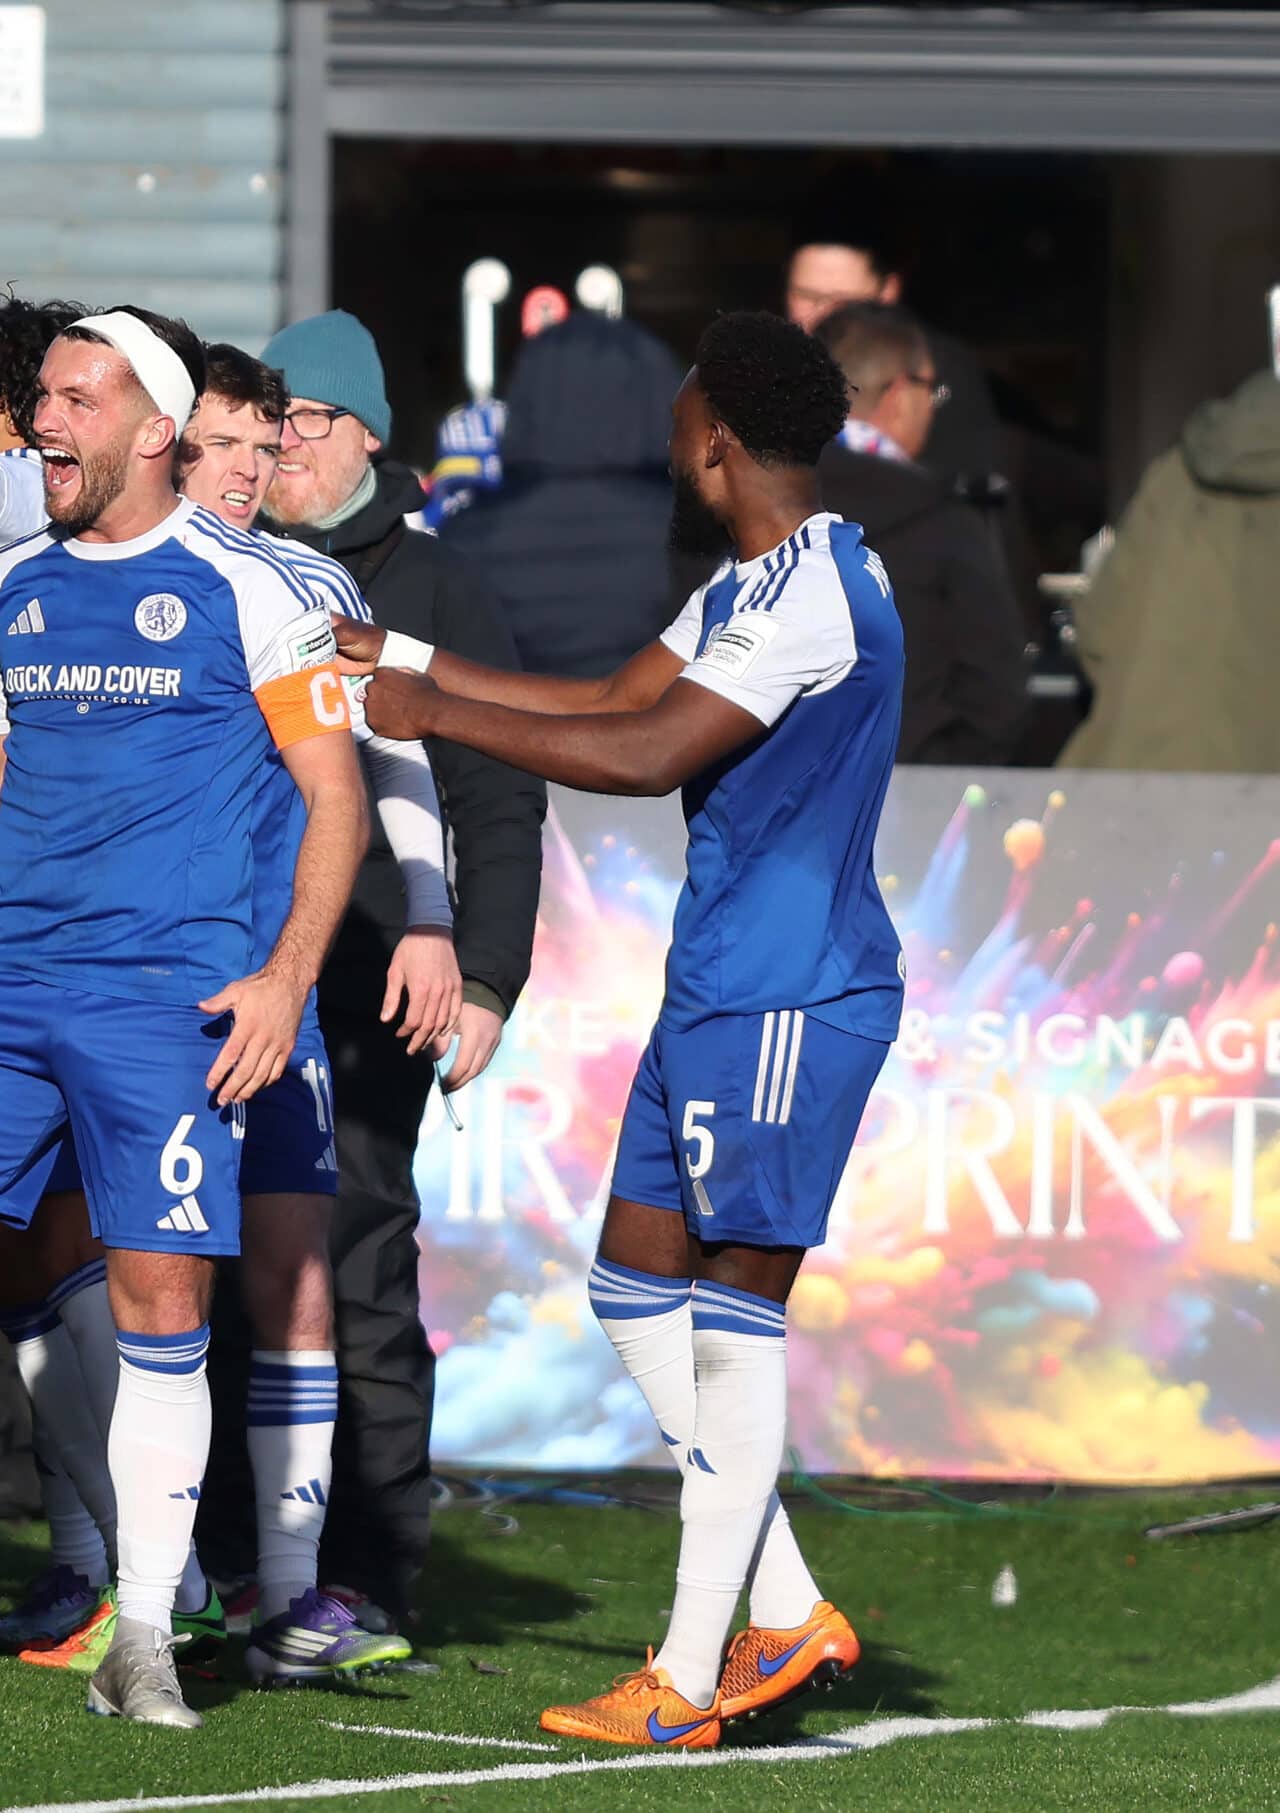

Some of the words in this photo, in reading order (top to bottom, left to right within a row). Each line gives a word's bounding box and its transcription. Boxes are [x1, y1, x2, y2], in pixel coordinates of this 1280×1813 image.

[54, 665, 101, 692] AND
[104, 666, 181, 697] COVER
[310, 671, 345, 727] C
[160, 1114, 203, 1195] 6
[682, 1100, 715, 1178] 5
